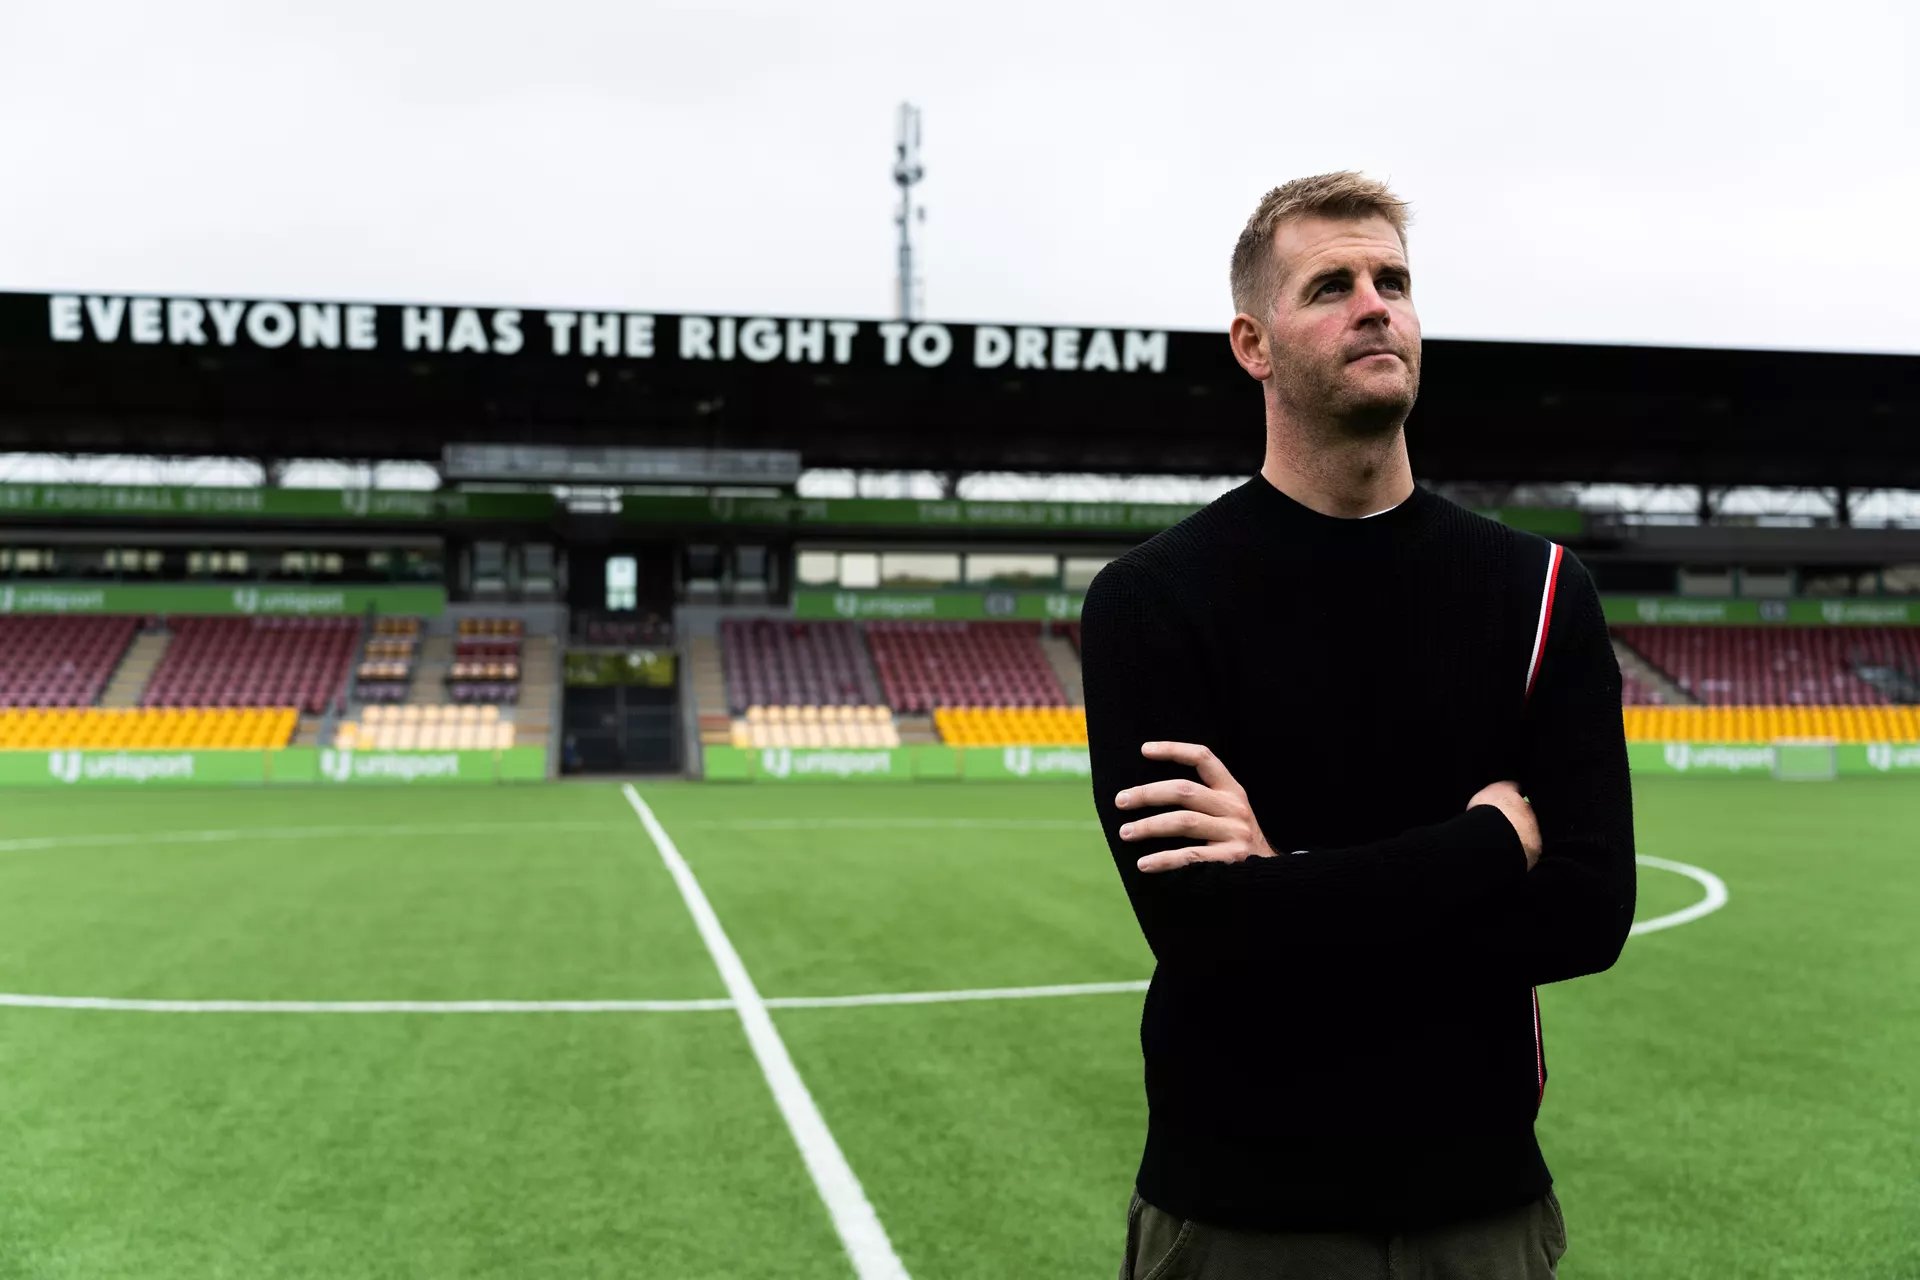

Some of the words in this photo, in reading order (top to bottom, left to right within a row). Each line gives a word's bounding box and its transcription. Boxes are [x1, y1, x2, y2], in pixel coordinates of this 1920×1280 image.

[49, 295, 377, 348] EVERYONE
[403, 306, 524, 354] HAS
[546, 312, 655, 357] THE
[679, 316, 859, 363] RIGHT
[878, 321, 953, 367] TO
[973, 326, 1168, 372] DREAM
[84, 754, 194, 782] unisport
[353, 753, 459, 781] unisport
[794, 750, 890, 778] unisport
